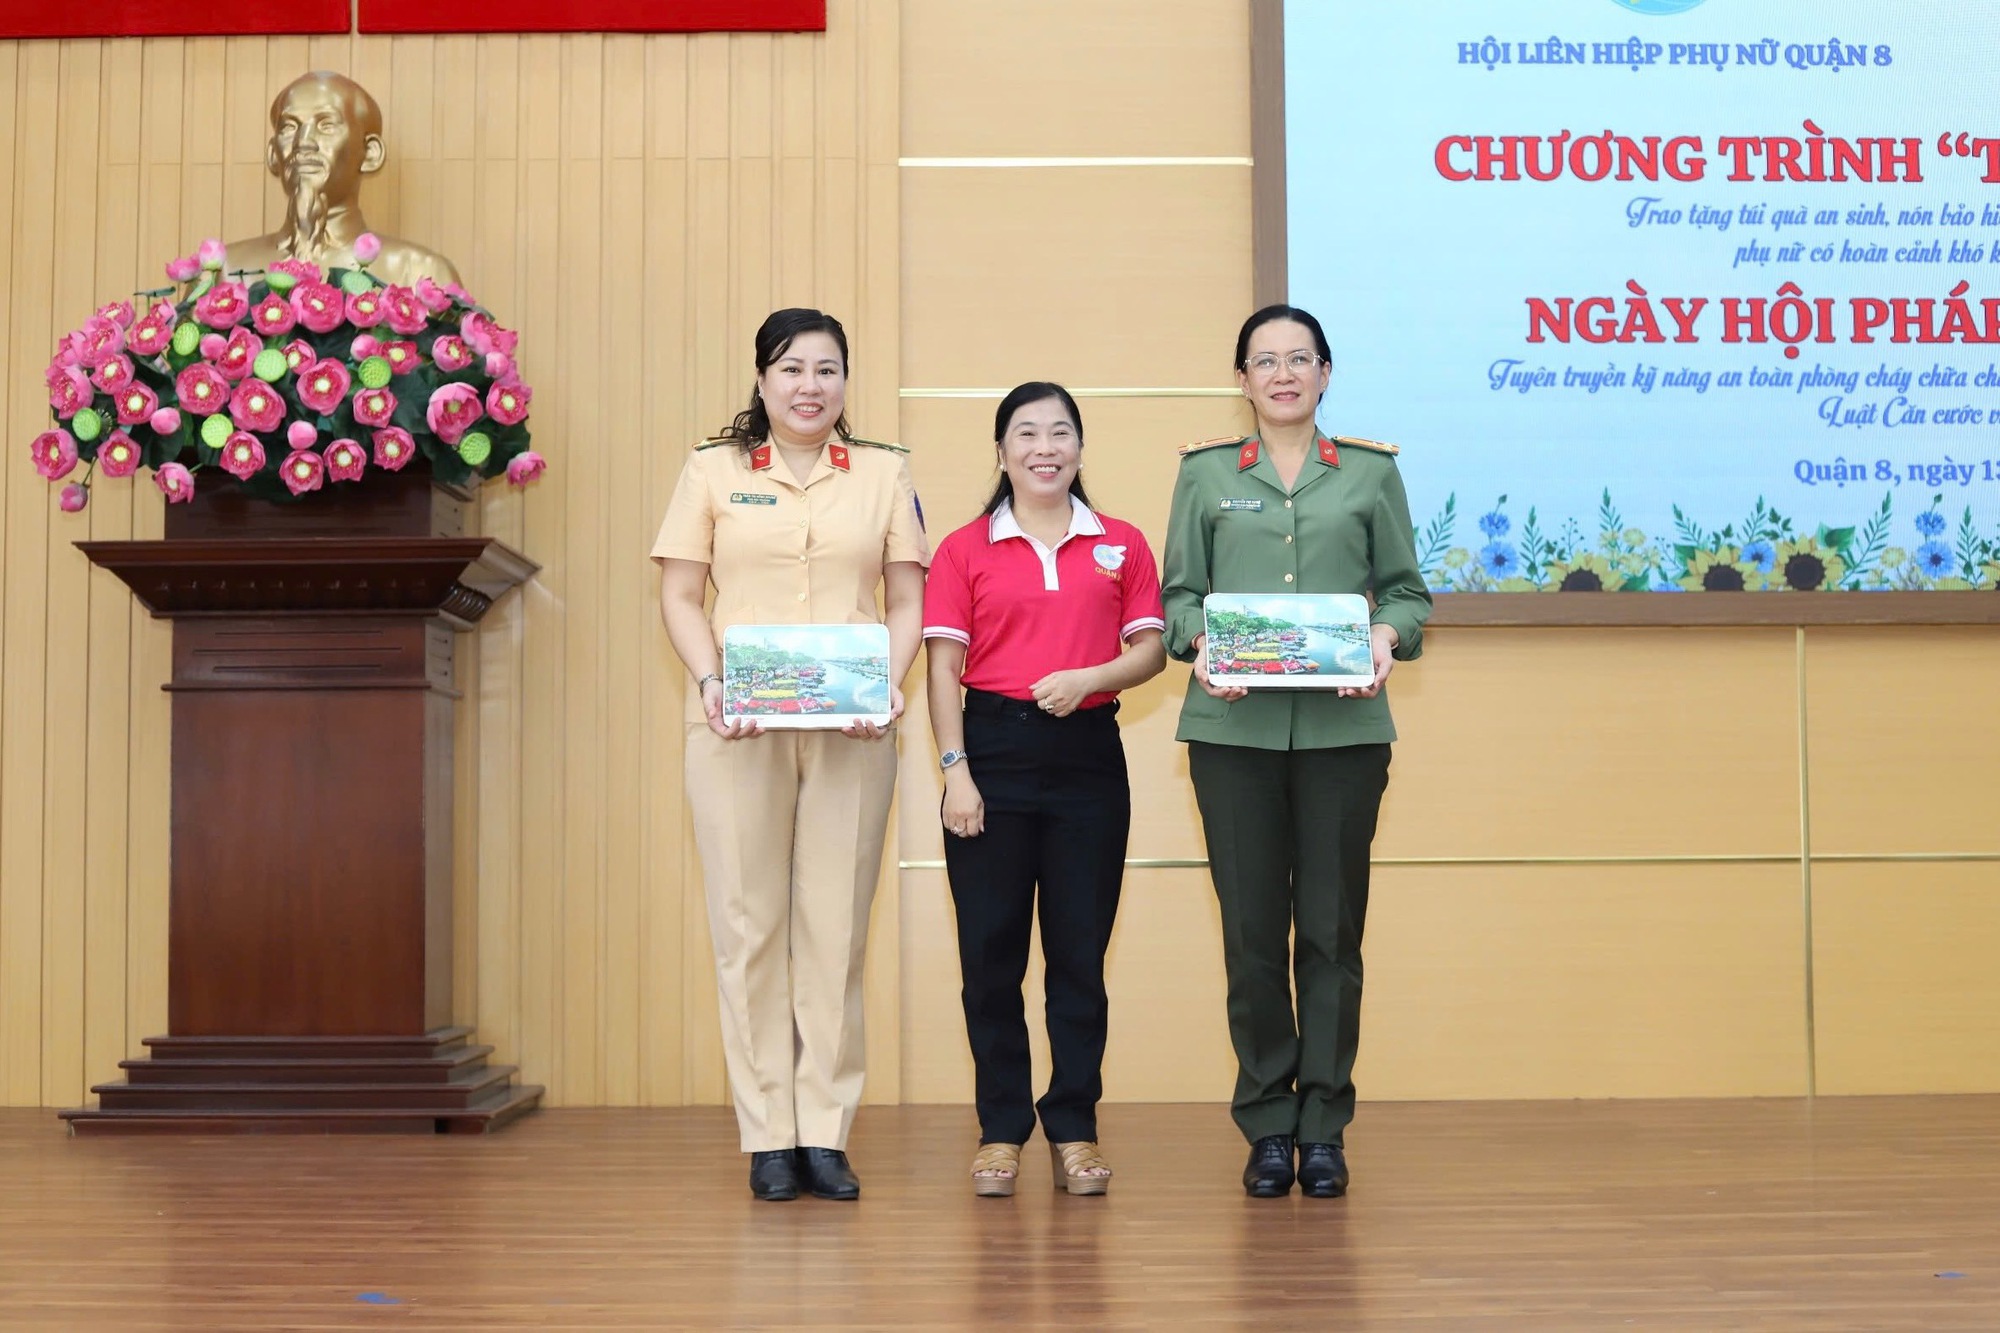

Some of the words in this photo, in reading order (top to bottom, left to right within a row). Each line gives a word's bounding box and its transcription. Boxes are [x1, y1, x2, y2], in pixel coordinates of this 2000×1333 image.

[1458, 36, 1511, 71] HỘI
[1518, 37, 1586, 65] LIÊN
[1592, 36, 1663, 72] HIỆP
[1668, 43, 1730, 72] PHỤ
[1736, 37, 1780, 66] NỮ
[1784, 37, 1868, 73] QUẬN
[1873, 44, 1893, 67] 8
[1434, 129, 1707, 182] CHƯƠNG
[1718, 119, 1924, 183] TRÌNH
[1625, 196, 1682, 229] Trao
[1688, 202, 1733, 232] tặng
[1738, 202, 1767, 226] túi
[1771, 204, 1808, 233] quà
[1814, 209, 1839, 226] an
[1846, 201, 1890, 228] sinh,
[1897, 205, 1933, 227] nón
[1939, 202, 1975, 227] bảo
[1733, 238, 1771, 269] phụ
[1776, 240, 1807, 264] nữ
[1810, 241, 1834, 264] có
[1839, 238, 1888, 264] hoàn
[1895, 239, 1942, 264] cảnh
[1947, 238, 1984, 264] khó
[1525, 279, 1709, 344] NGÀY
[1720, 281, 1836, 359] HỘI
[1487, 358, 1557, 395] Tuyên
[1563, 361, 1627, 395] truyền
[1631, 362, 1659, 394] kỹ
[1661, 366, 1712, 394] năng
[1717, 370, 1743, 388] an
[1748, 364, 1793, 388] toàn
[1796, 363, 1860, 395] phòng
[1864, 362, 1912, 395] cháy
[1918, 362, 1968, 389] chữa
[1974, 362, 2000, 389] ch
[1818, 395, 1879, 430] Luật
[1882, 394, 1926, 429] Căn
[1932, 403, 1983, 426] cước
[1793, 456, 1868, 488] Quận
[1874, 459, 1901, 487] 8,
[1907, 455, 1975, 488] ngày
